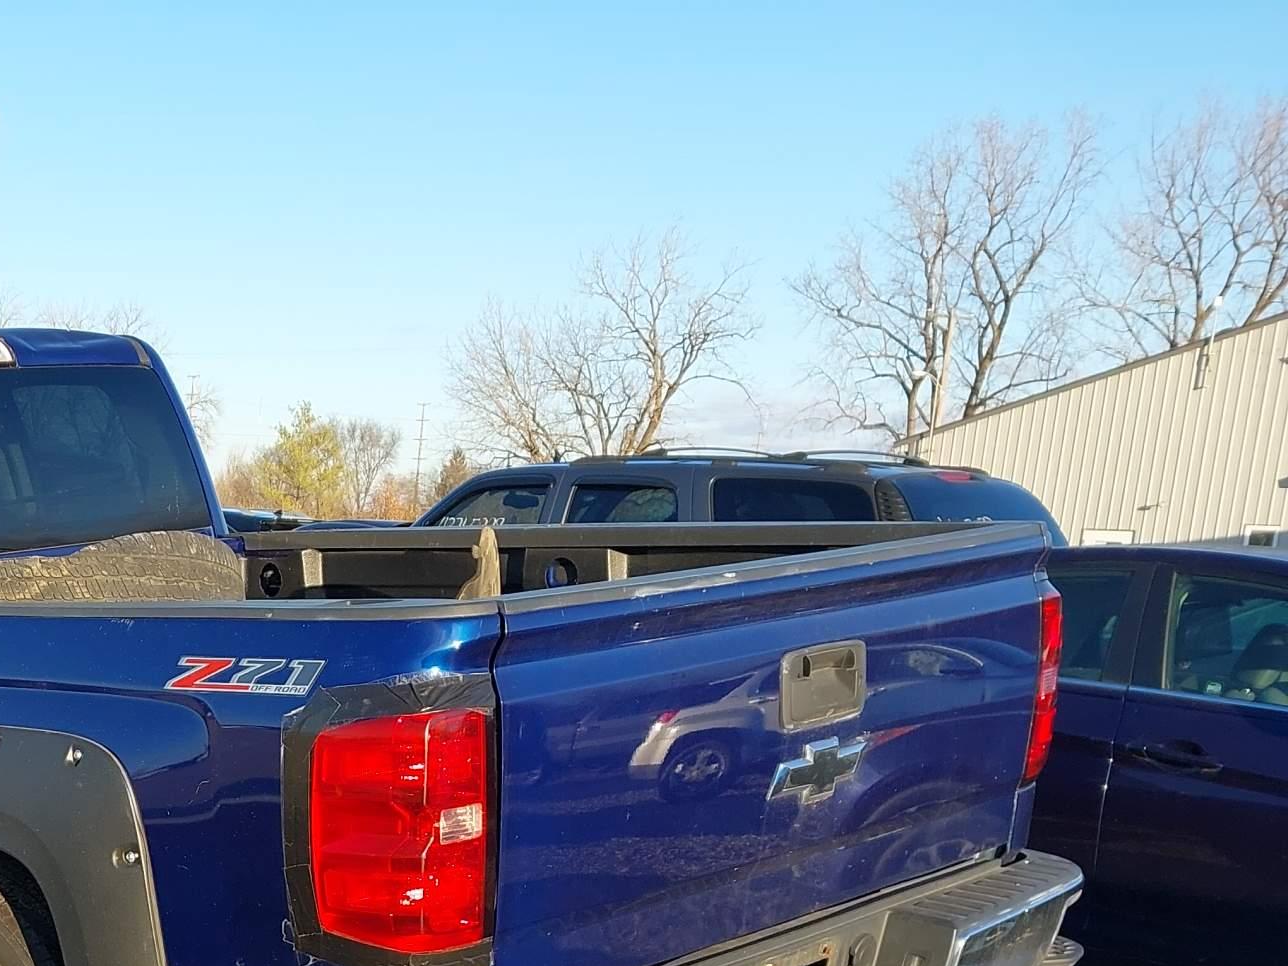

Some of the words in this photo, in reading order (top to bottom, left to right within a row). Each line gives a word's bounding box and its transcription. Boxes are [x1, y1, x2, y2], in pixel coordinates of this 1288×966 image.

[164, 656, 328, 693] Z71
[250, 685, 272, 693] OFF
[273, 685, 307, 694] ROAD
